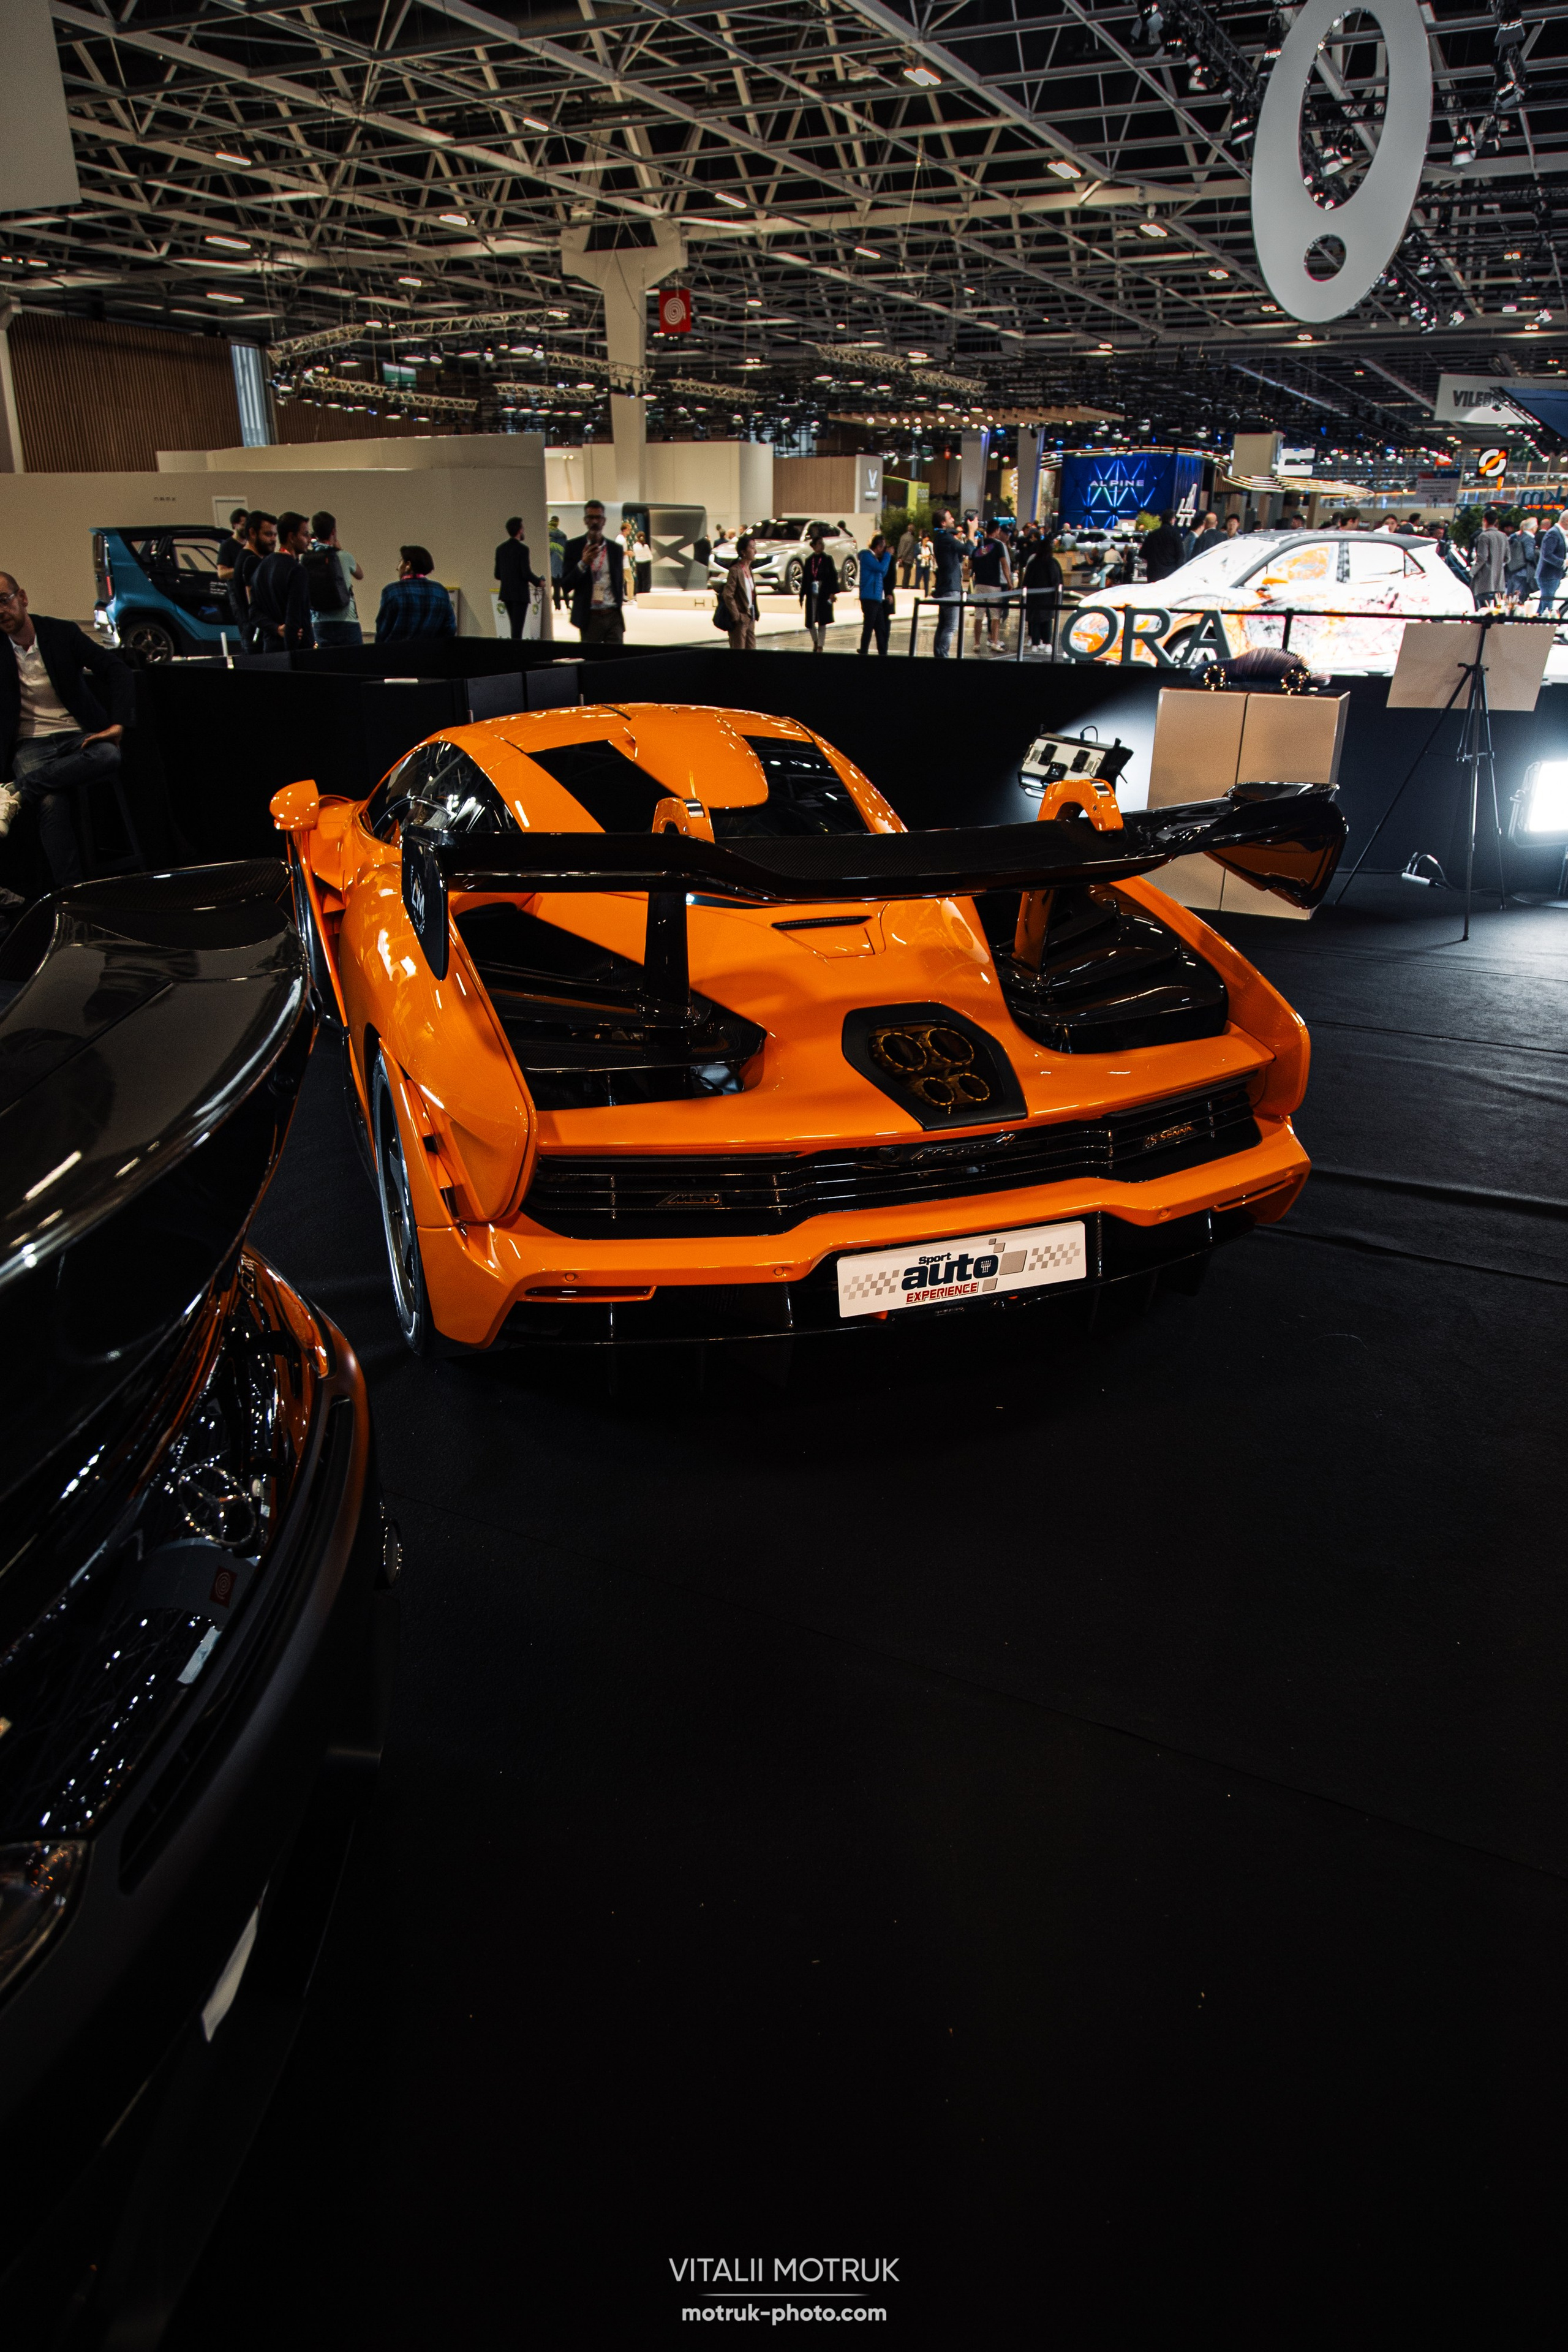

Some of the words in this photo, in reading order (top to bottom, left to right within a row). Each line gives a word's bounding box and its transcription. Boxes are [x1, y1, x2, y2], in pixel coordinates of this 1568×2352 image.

[1061, 606, 1232, 668] ORA
[901, 1253, 998, 1290] auto
[919, 1253, 952, 1265] Sport
[906, 1282, 979, 1303] EXPERIENCE
